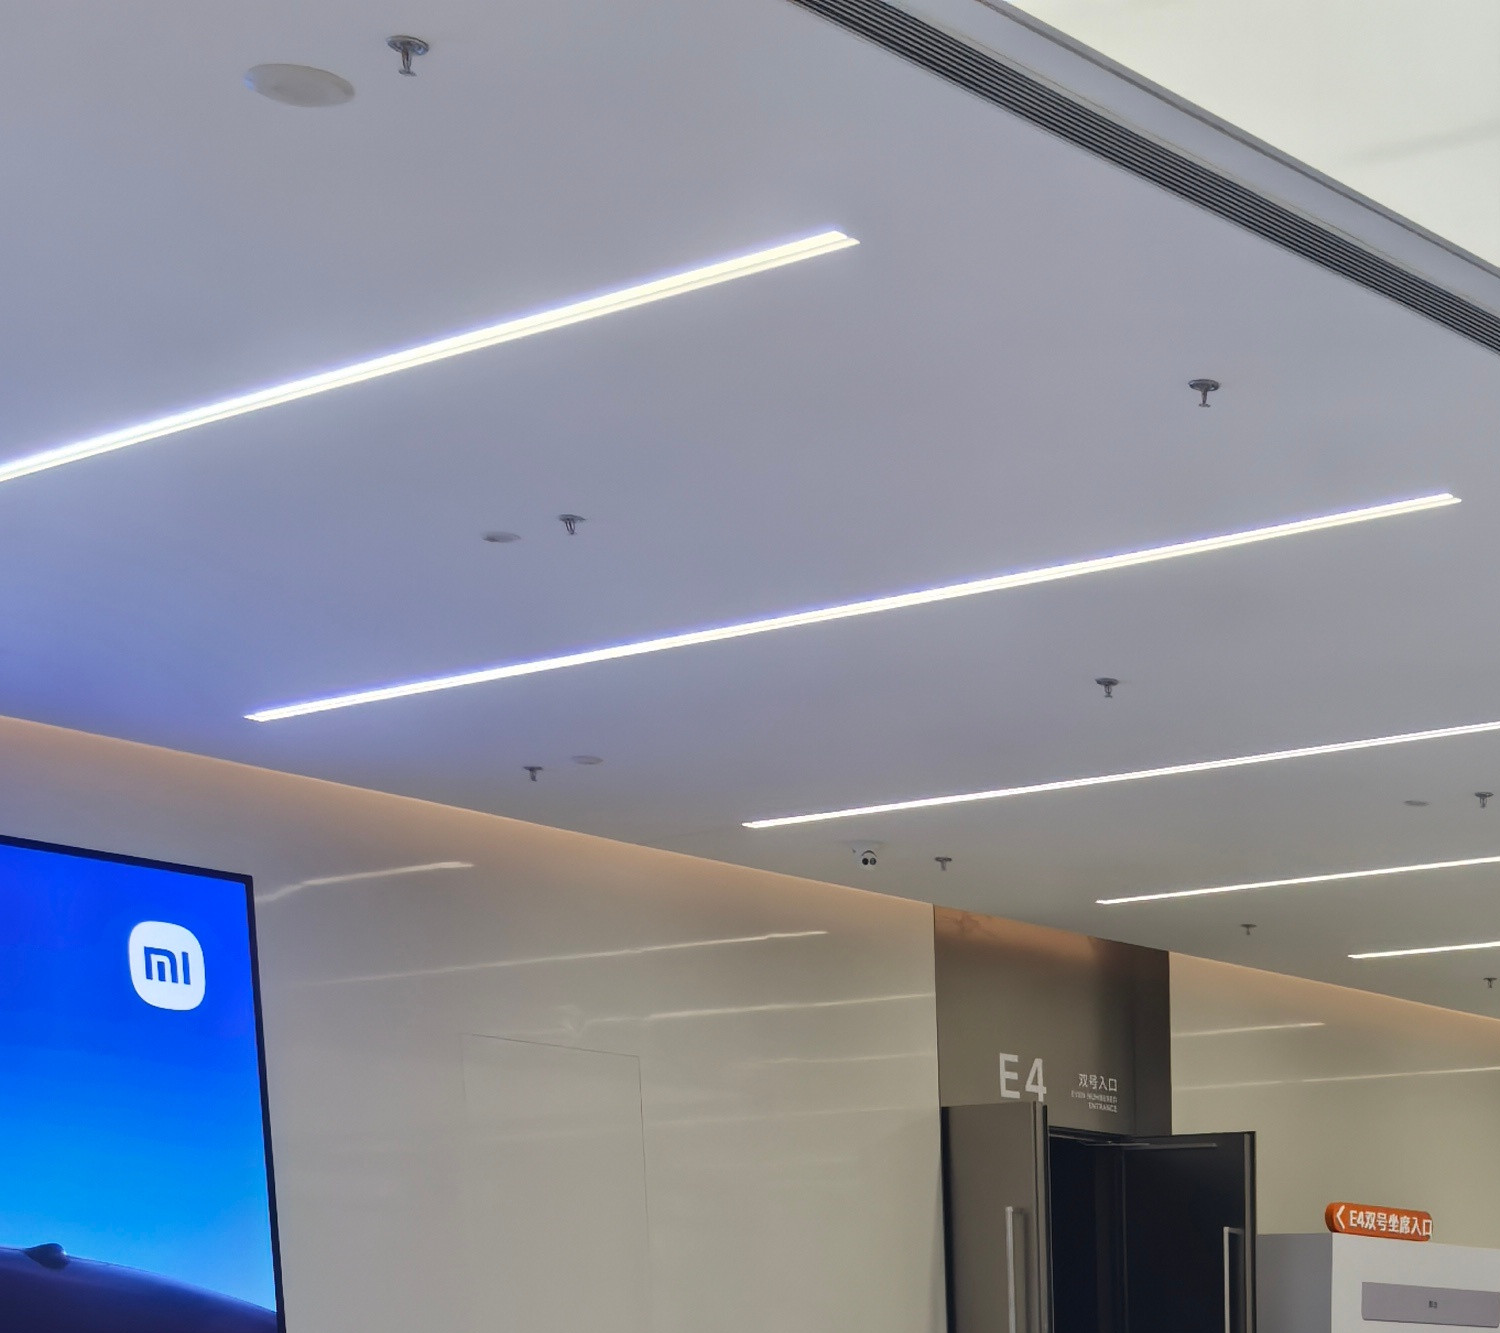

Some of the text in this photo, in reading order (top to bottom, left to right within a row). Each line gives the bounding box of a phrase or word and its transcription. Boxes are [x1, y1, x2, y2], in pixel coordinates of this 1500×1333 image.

[999, 1052, 1047, 1102] E4
[1078, 1073, 1118, 1092] 双号入口
